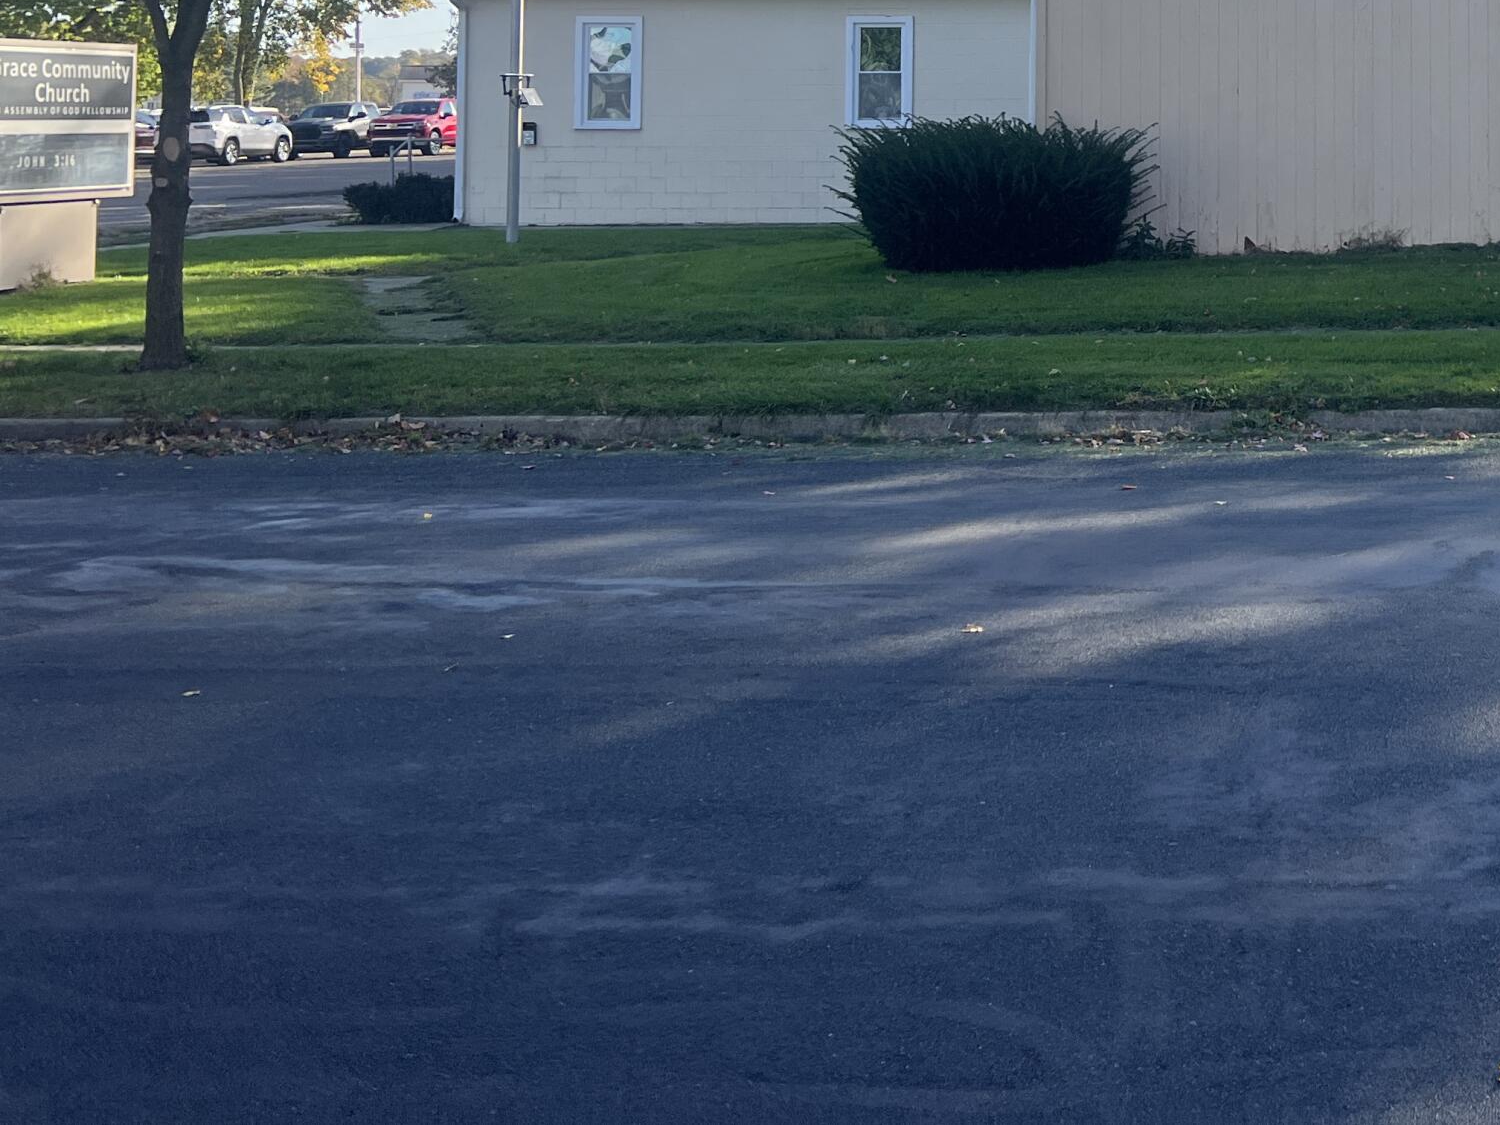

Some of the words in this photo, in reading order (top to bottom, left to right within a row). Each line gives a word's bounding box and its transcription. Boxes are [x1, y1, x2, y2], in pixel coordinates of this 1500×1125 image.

[42, 59, 131, 84] Community
[35, 82, 90, 103] Church
[4, 106, 47, 115] ASSEMBLY
[49, 106, 61, 115] OF
[62, 106, 79, 115] GOD
[82, 106, 129, 115] FELLOWSHIP
[16, 155, 46, 168] JOHN
[54, 154, 76, 167] 3:16
